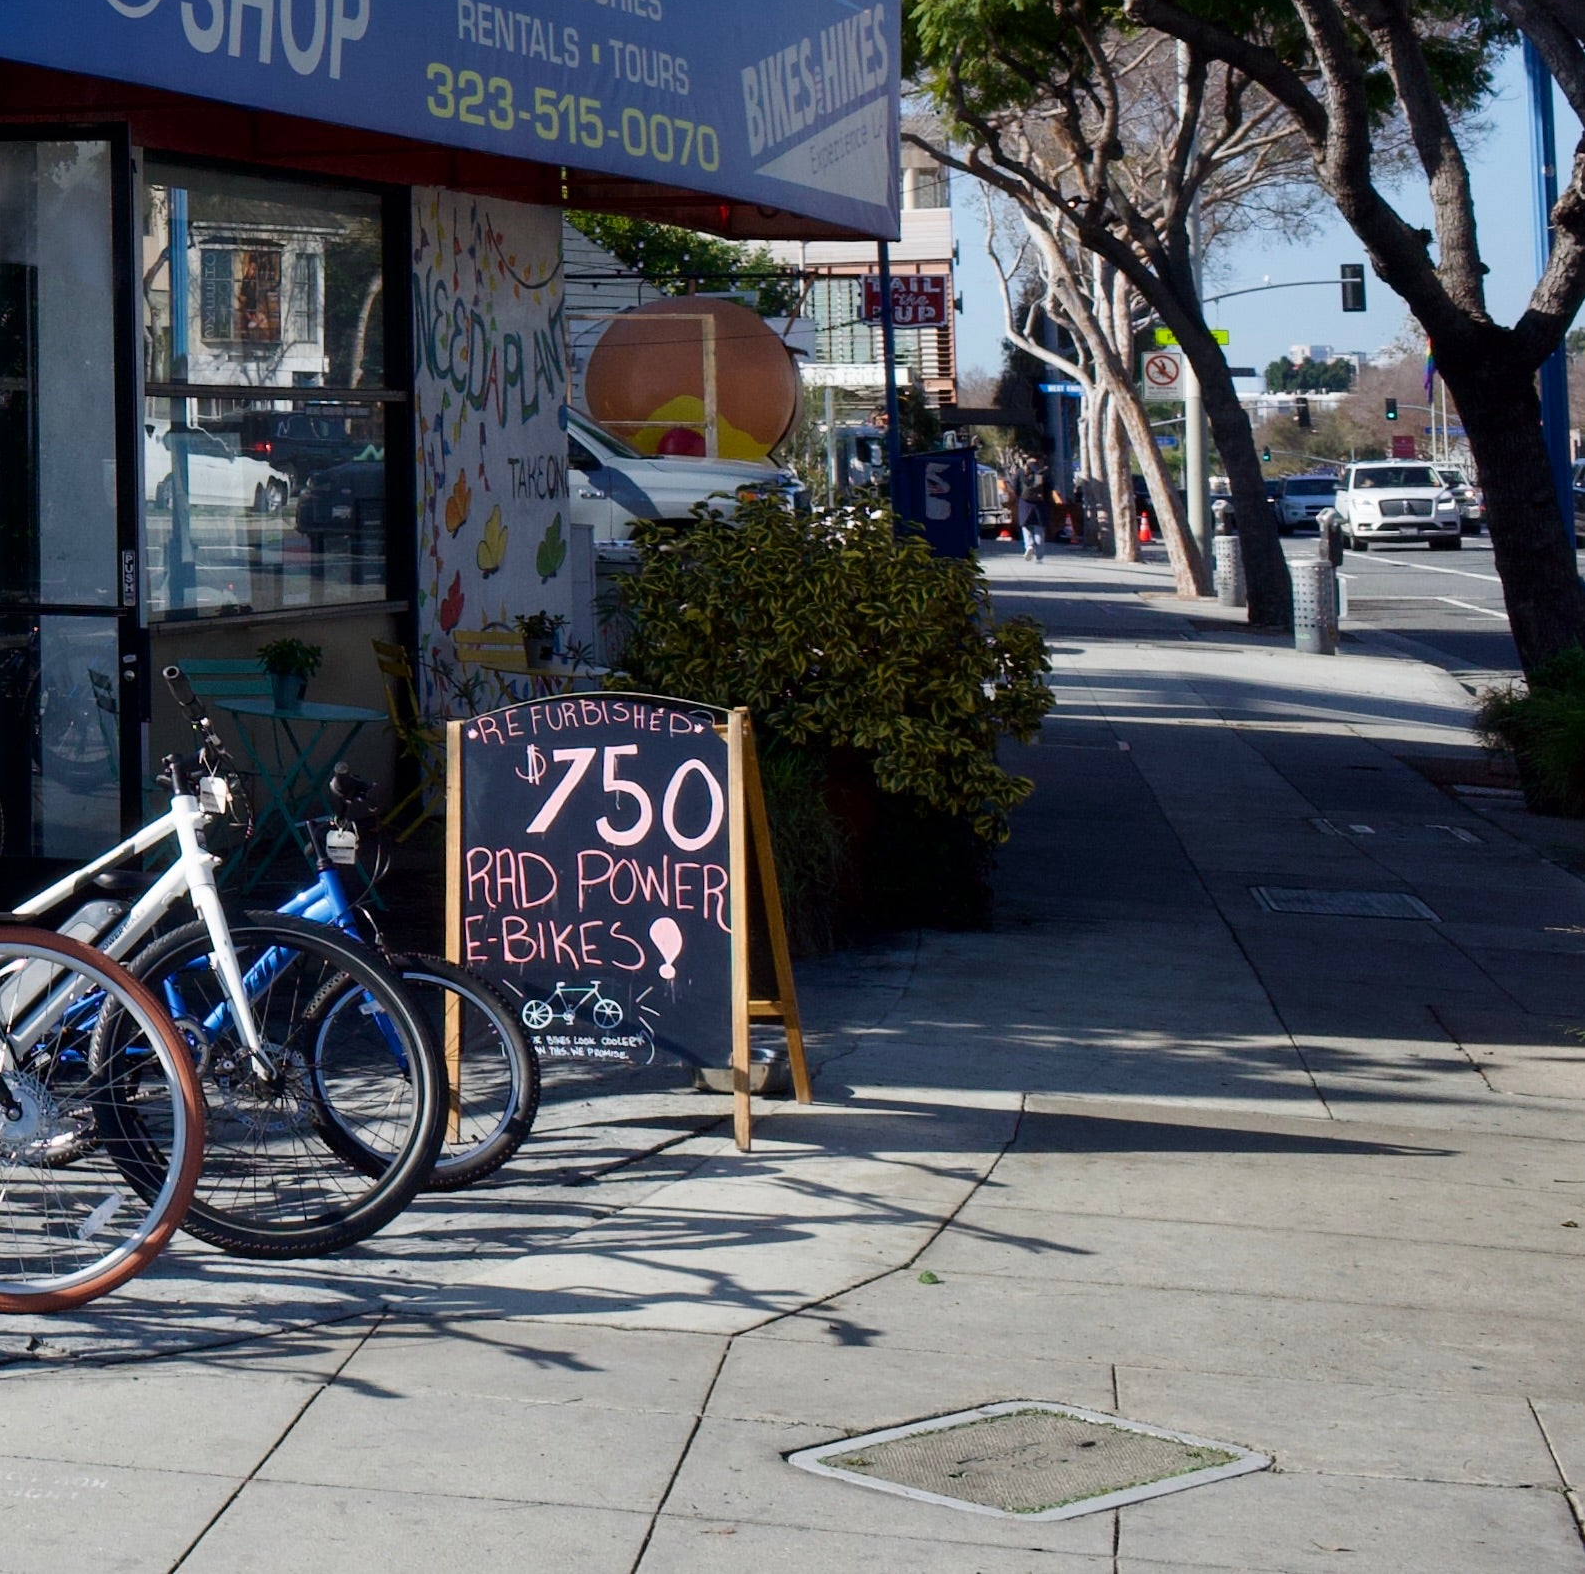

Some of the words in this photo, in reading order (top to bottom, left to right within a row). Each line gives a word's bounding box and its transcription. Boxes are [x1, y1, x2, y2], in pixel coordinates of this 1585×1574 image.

[609, 39, 689, 95] TOURS
[741, 37, 817, 157] BIKES
[820, 3, 889, 114] HIKES
[426, 63, 720, 172] 323-515-0070
[866, 277, 941, 293] TAIL
[412, 265, 487, 412] NEED
[502, 292, 565, 429] PLANT
[507, 456, 545, 500] TAKE
[124, 554, 134, 592] PUSH
[477, 699, 693, 744] REFURBISHED
[515, 743, 724, 852] $750
[466, 847, 558, 909] RAD
[576, 849, 732, 934] POWER
[545, 1035, 571, 1045] BIKES
[573, 1036, 596, 1045] LOOK
[572, 1047, 584, 1057] WE
